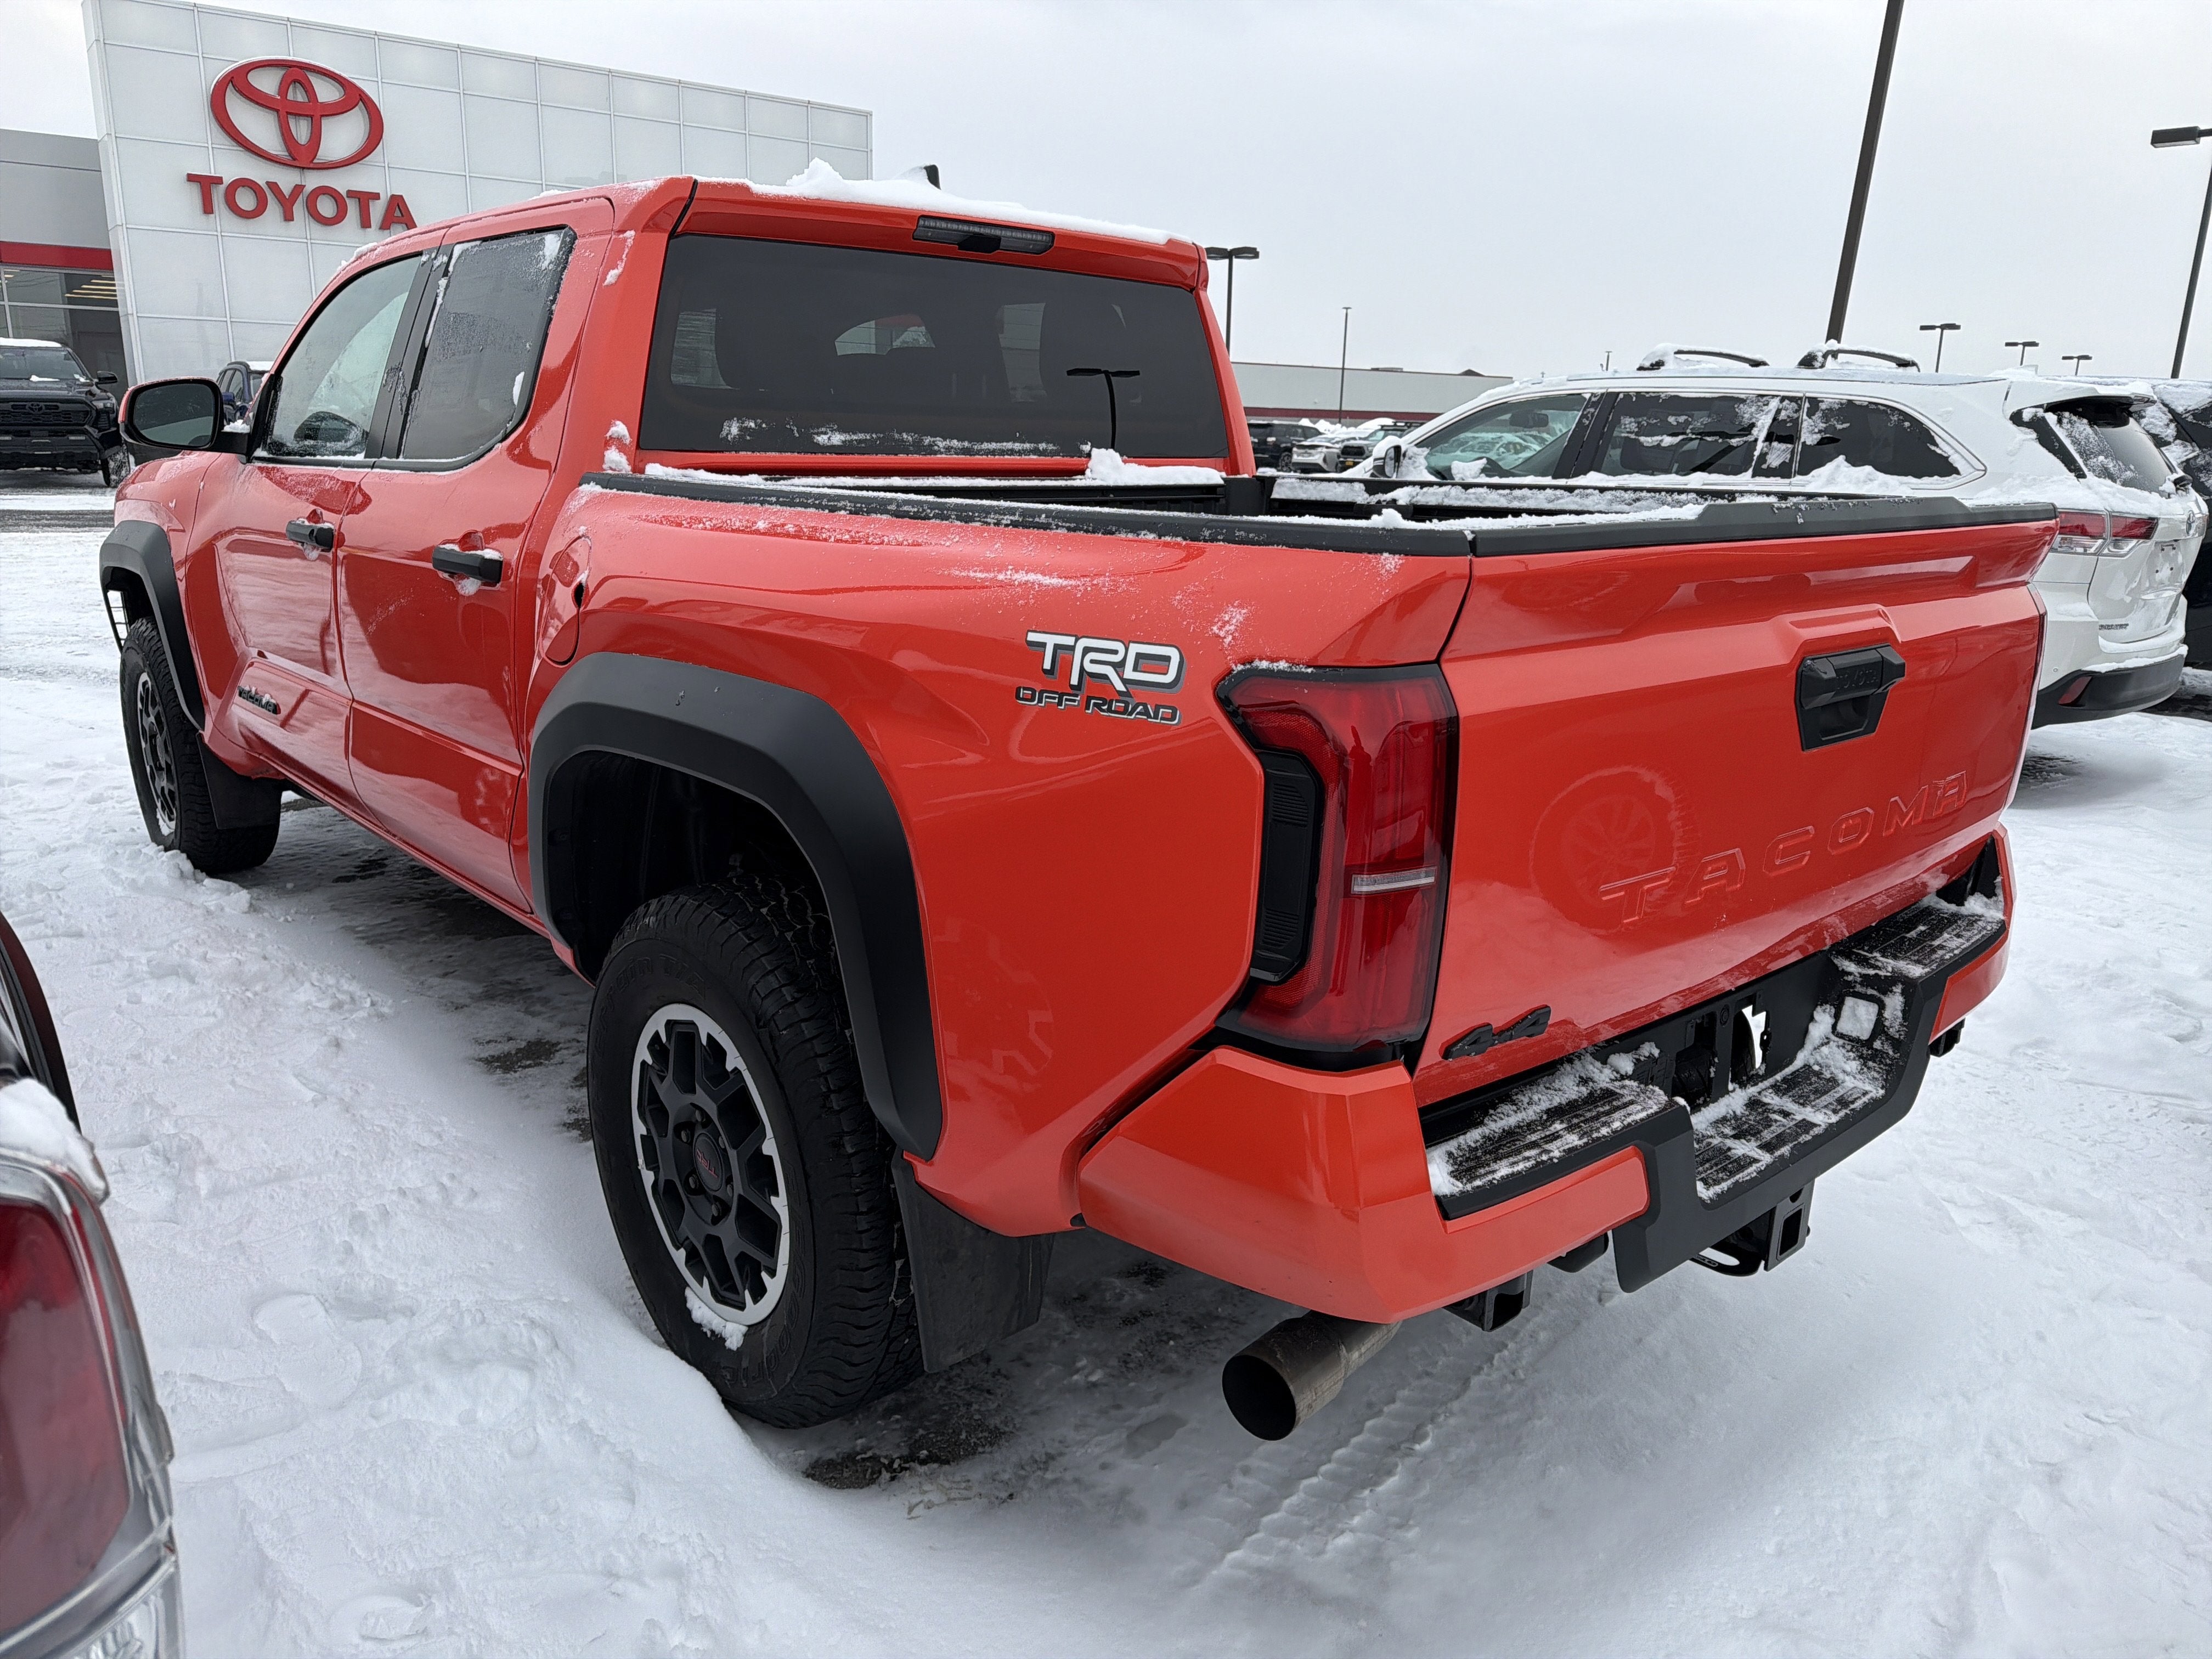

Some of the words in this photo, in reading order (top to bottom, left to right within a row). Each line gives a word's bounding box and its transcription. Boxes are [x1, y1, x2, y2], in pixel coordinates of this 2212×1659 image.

[187, 173, 417, 229] TOYOTA
[1025, 630, 1186, 698] TRD
[1015, 686, 1080, 709] OFF
[1085, 696, 1182, 725] ROAD
[1599, 770, 1967, 923] TACOMA
[696, 1149, 719, 1179] TRD
[707, 1158, 806, 1388] BFGoodric
